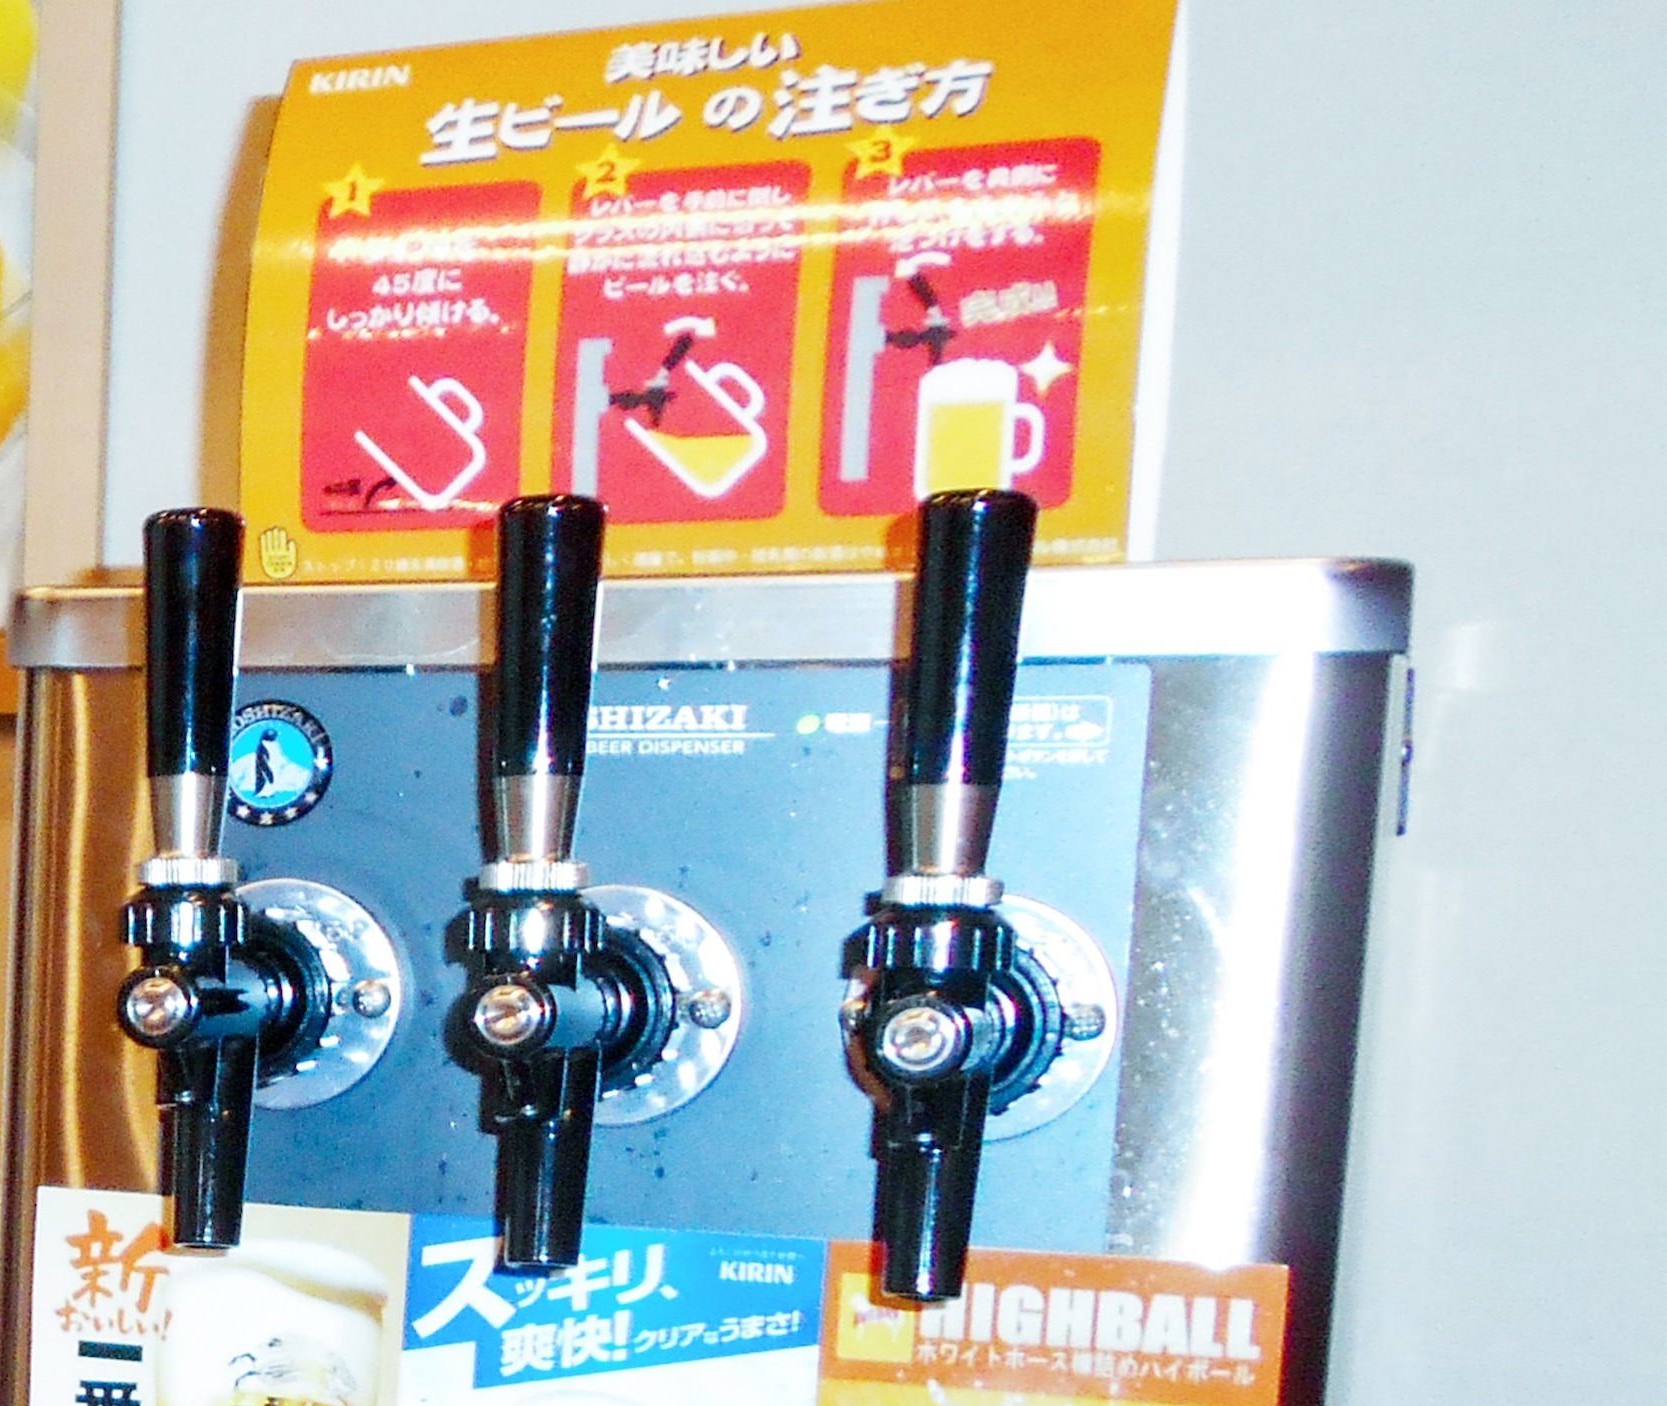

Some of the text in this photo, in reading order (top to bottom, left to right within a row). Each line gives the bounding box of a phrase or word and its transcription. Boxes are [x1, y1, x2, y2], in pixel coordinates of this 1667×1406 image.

[604, 32, 801, 85] 美味しい
[308, 64, 411, 95] KIRIN
[871, 139, 893, 163] 3
[596, 161, 619, 184] 2
[347, 180, 358, 202] 1
[372, 267, 463, 297] 45度に
[602, 272, 751, 300] ビールを注ぐ。
[326, 298, 501, 330] しっかり傾ける。
[233, 704, 327, 743] OSHIZAKI
[587, 704, 748, 731] SHIZAKI
[586, 740, 745, 756] BEER DISPENSER
[66, 1208, 171, 1314] 新
[719, 1260, 794, 1285] KIRIN
[919, 1281, 1261, 1360] HIGHBALL
